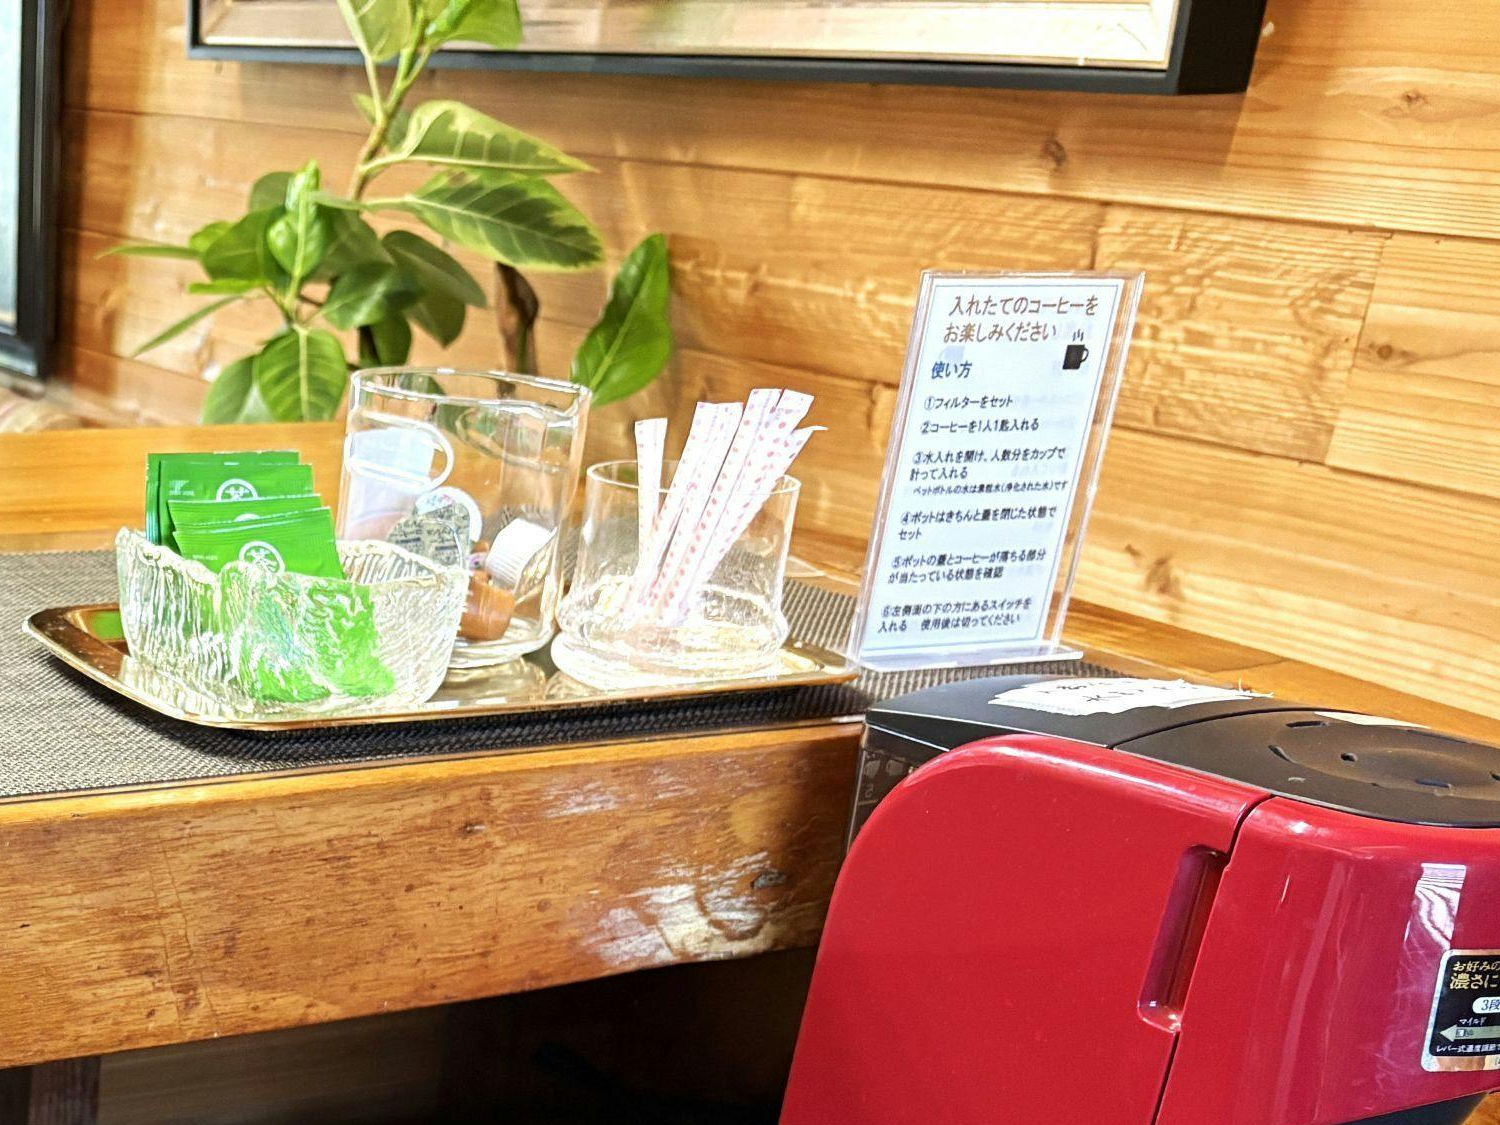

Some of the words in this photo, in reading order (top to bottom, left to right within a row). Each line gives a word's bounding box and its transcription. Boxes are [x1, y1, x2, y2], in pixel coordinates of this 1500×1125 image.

[949, 294, 1098, 316] 入れたてのコーヒーを
[944, 321, 1056, 343] お楽しみください
[931, 361, 972, 379] 使い方
[924, 395, 1013, 411] ①フィルターをセット
[909, 466, 968, 481] 計って入れる
[898, 527, 922, 541] セット
[888, 566, 1004, 584] が当たっている状態を確認
[878, 620, 907, 633] 入れる
[920, 613, 1020, 631] 使用後は切ってください
